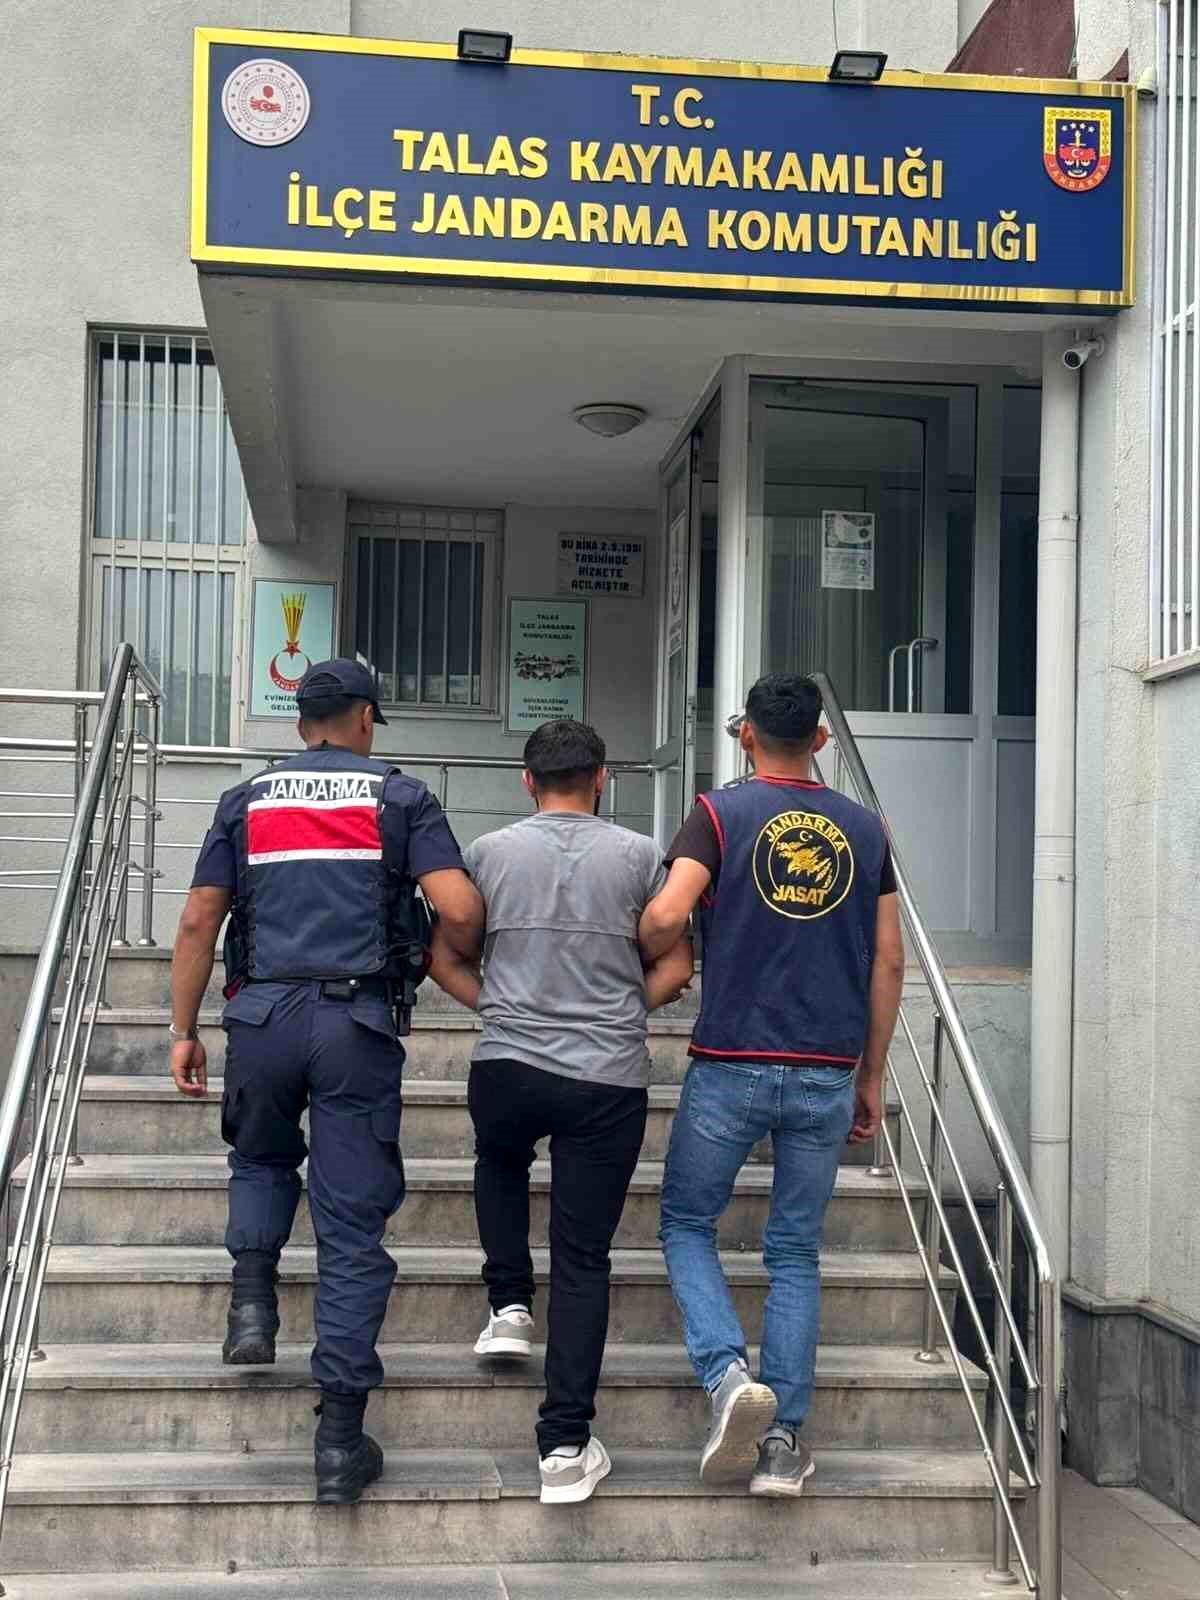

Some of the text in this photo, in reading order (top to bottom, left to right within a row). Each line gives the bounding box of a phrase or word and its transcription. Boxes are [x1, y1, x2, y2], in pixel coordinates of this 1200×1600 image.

[631, 84, 715, 130] T.C.
[392, 129, 944, 200] TALAS KAYMAKAMLIĞI
[287, 171, 1038, 263] İLÇE JANDARMA KOMUTANLIĞI
[262, 778, 372, 801] JANDARMA
[765, 814, 847, 853] JANDARMA
[772, 884, 828, 906] JASAT
